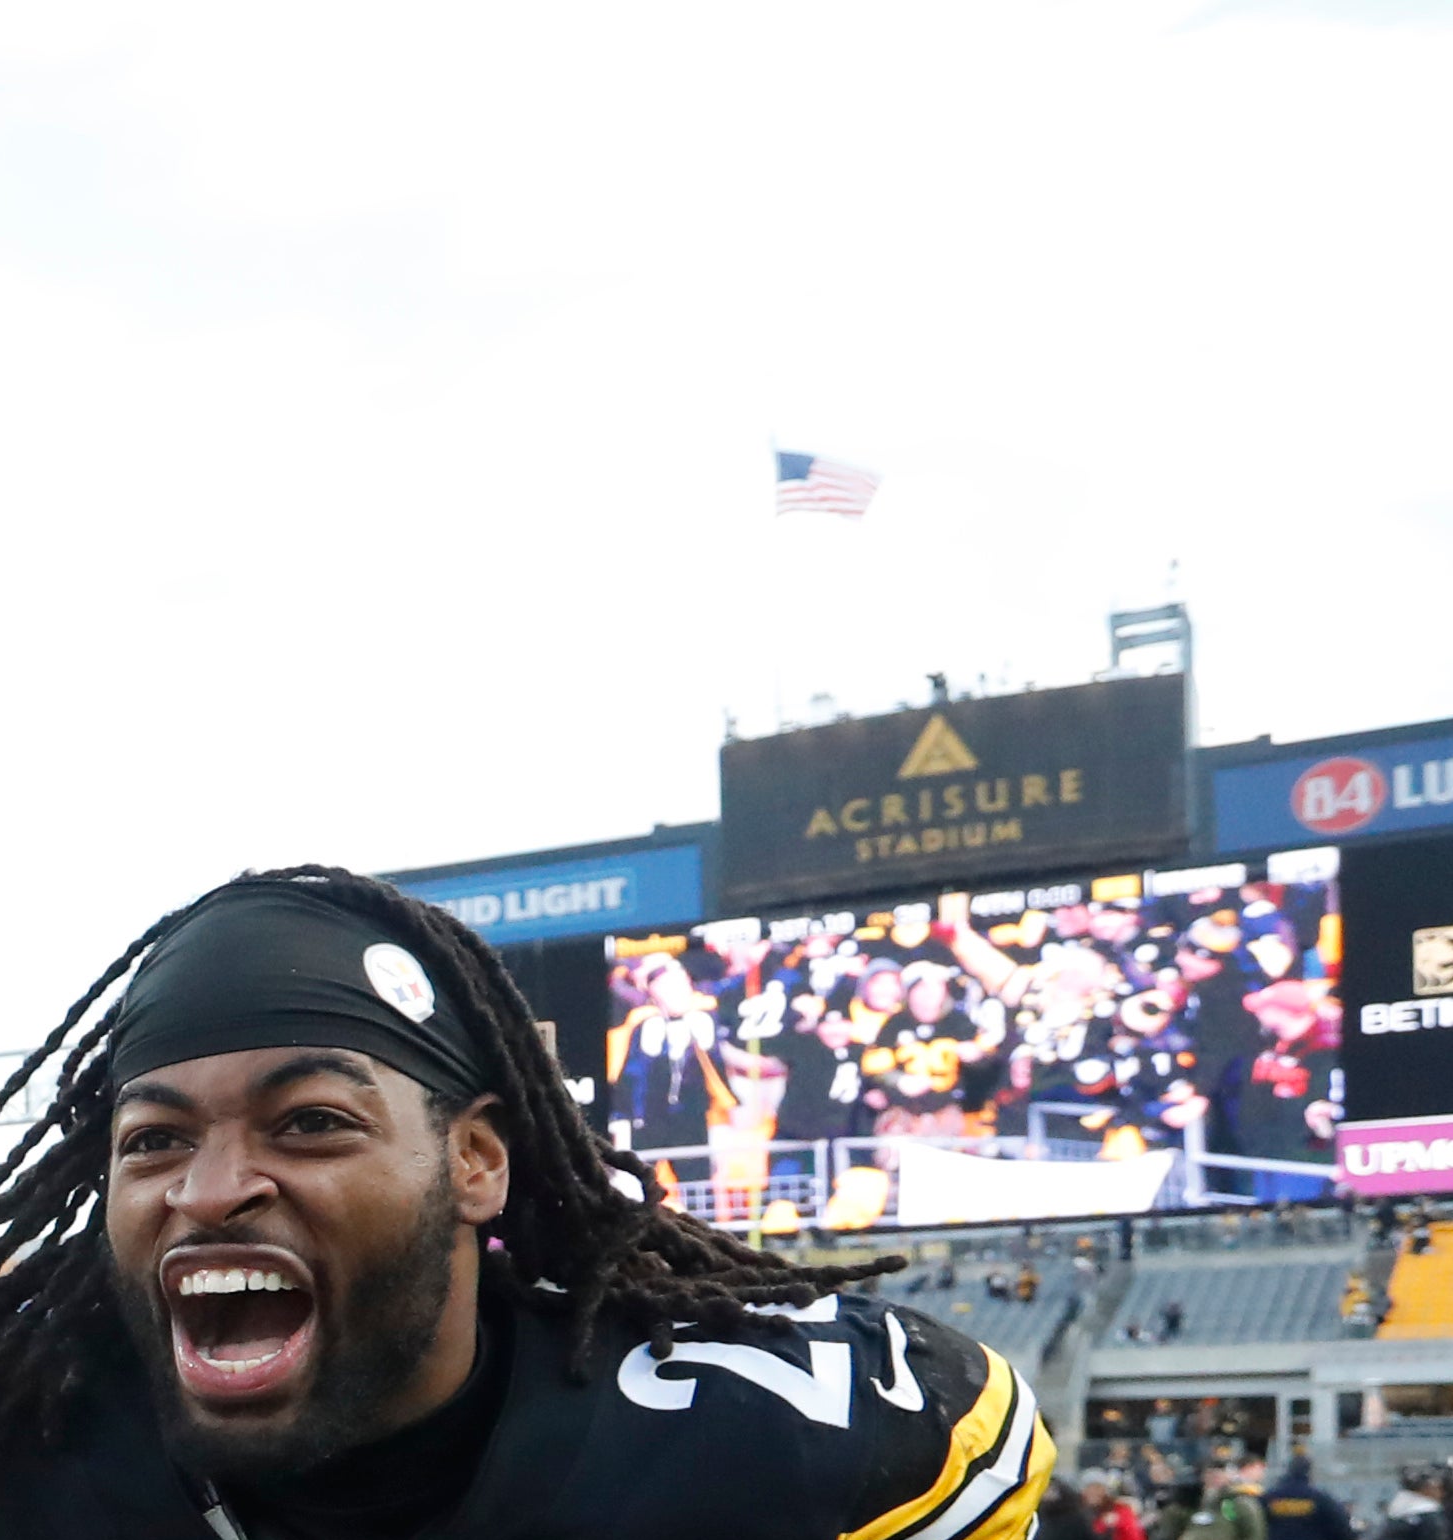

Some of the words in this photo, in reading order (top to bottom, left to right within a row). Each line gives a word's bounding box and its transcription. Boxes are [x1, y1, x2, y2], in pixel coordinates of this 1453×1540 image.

[804, 768, 1084, 840] ACRISURE
[1301, 769, 1373, 822] 84
[855, 817, 1023, 863] STADIUM
[431, 894, 502, 926] UD
[504, 876, 627, 922] LIGHT
